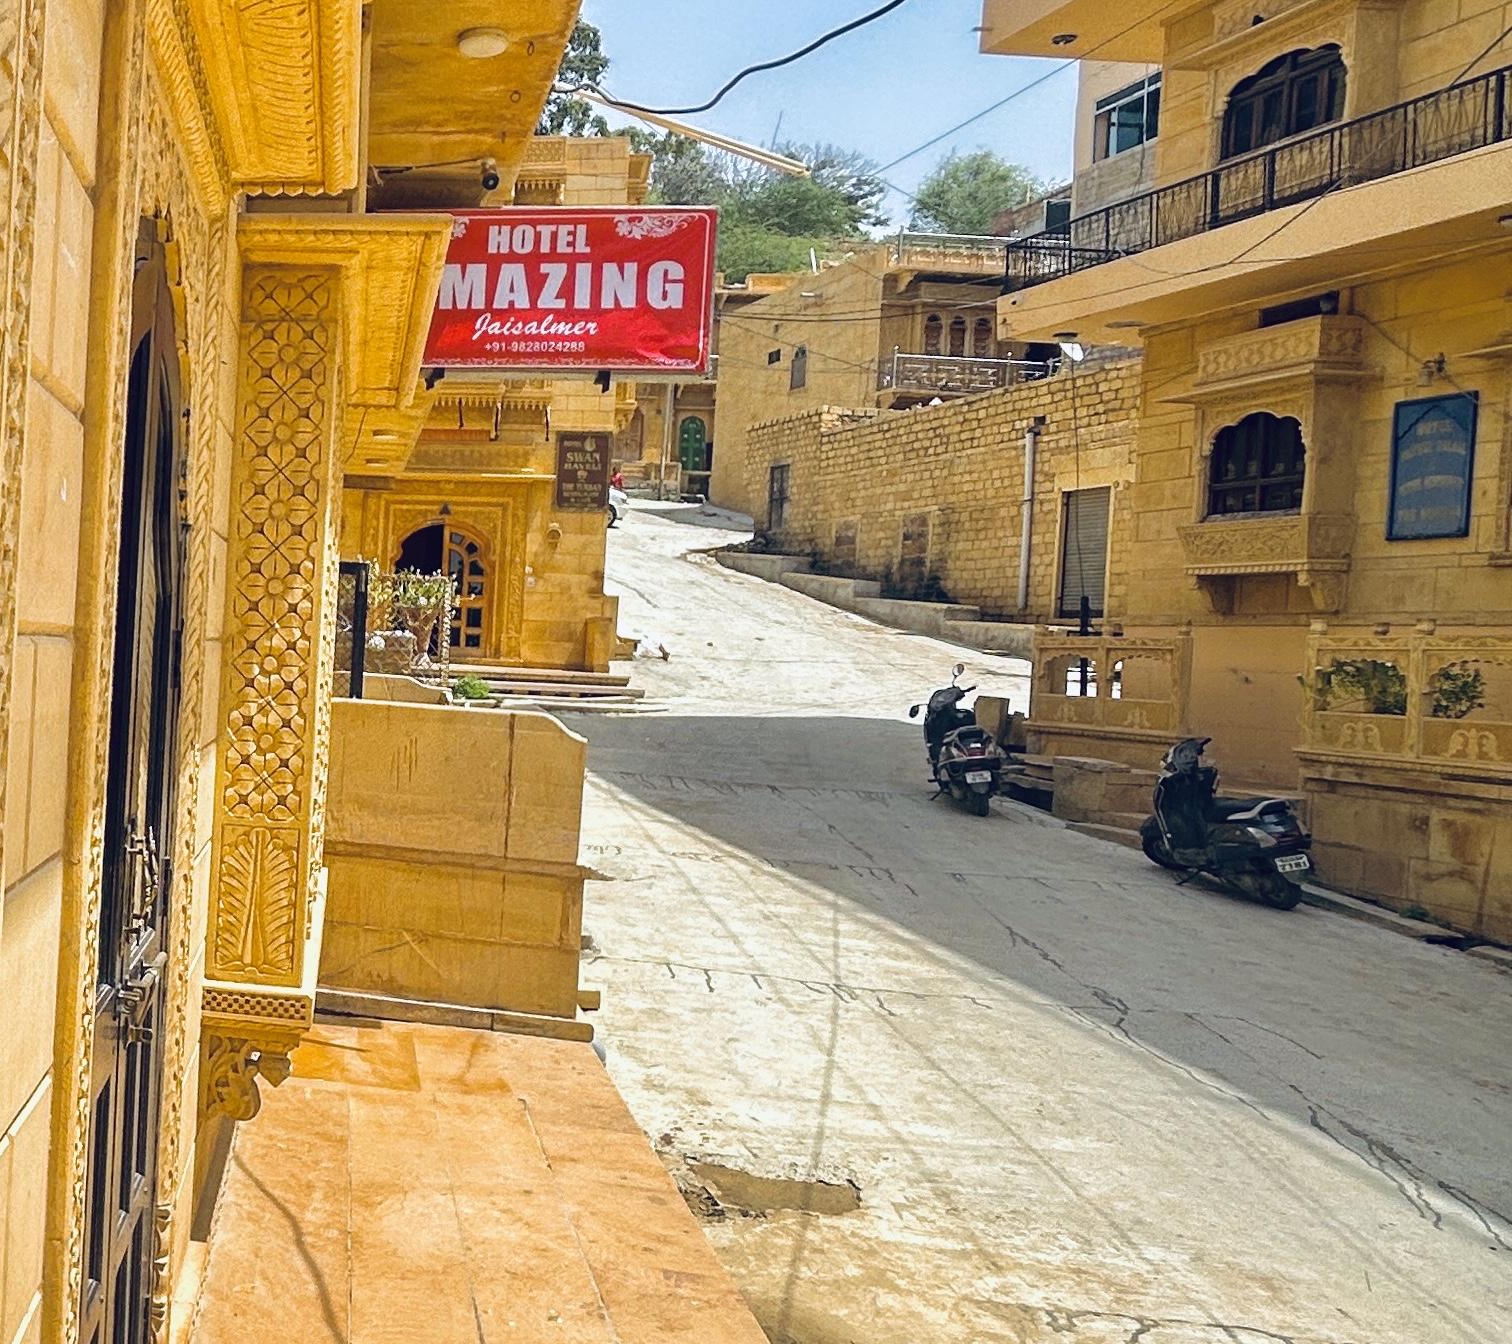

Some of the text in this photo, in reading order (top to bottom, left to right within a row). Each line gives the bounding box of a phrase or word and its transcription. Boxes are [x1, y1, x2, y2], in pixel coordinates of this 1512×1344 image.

[488, 224, 591, 254] HOTEL
[471, 312, 599, 341] Jaisalmer
[566, 451, 601, 463] SWAN
